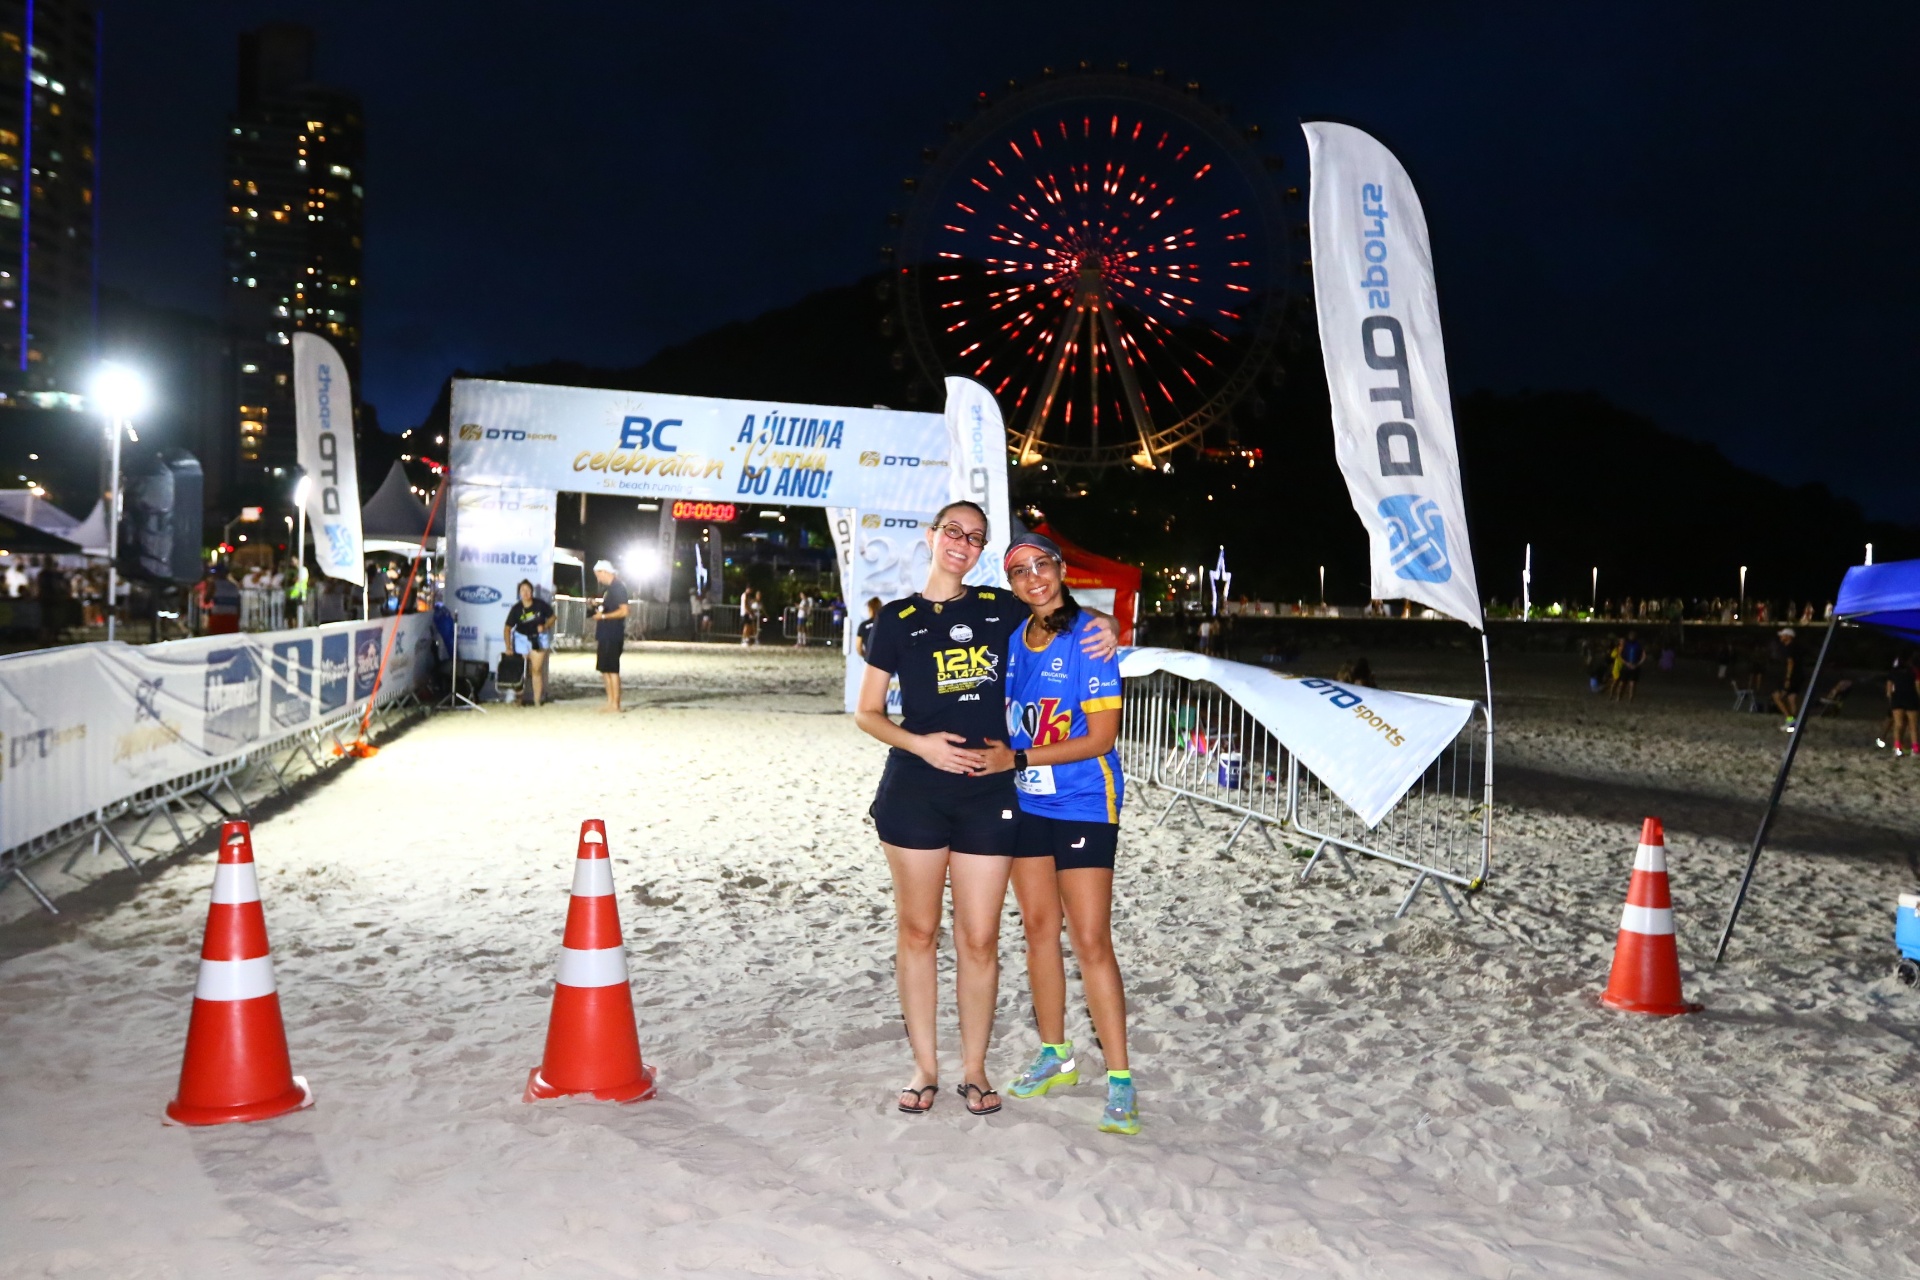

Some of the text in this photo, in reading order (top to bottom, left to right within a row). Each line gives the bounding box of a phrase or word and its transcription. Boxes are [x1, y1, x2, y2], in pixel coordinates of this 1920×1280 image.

[486, 428, 526, 441] DTO
[619, 415, 683, 452] BC
[737, 410, 845, 449] A ÚLTIMA
[573, 438, 725, 480] celebration
[883, 455, 920, 467] DTO
[618, 479, 650, 490] beach
[736, 464, 833, 499] DO ANO!
[673, 501, 735, 521] 00:00:00
[884, 518, 919, 529] DTO
[459, 546, 538, 566] Manatex
[458, 588, 499, 600] TROPICAL
[932, 645, 992, 672] 12K
[1300, 679, 1406, 747] DTO sports
